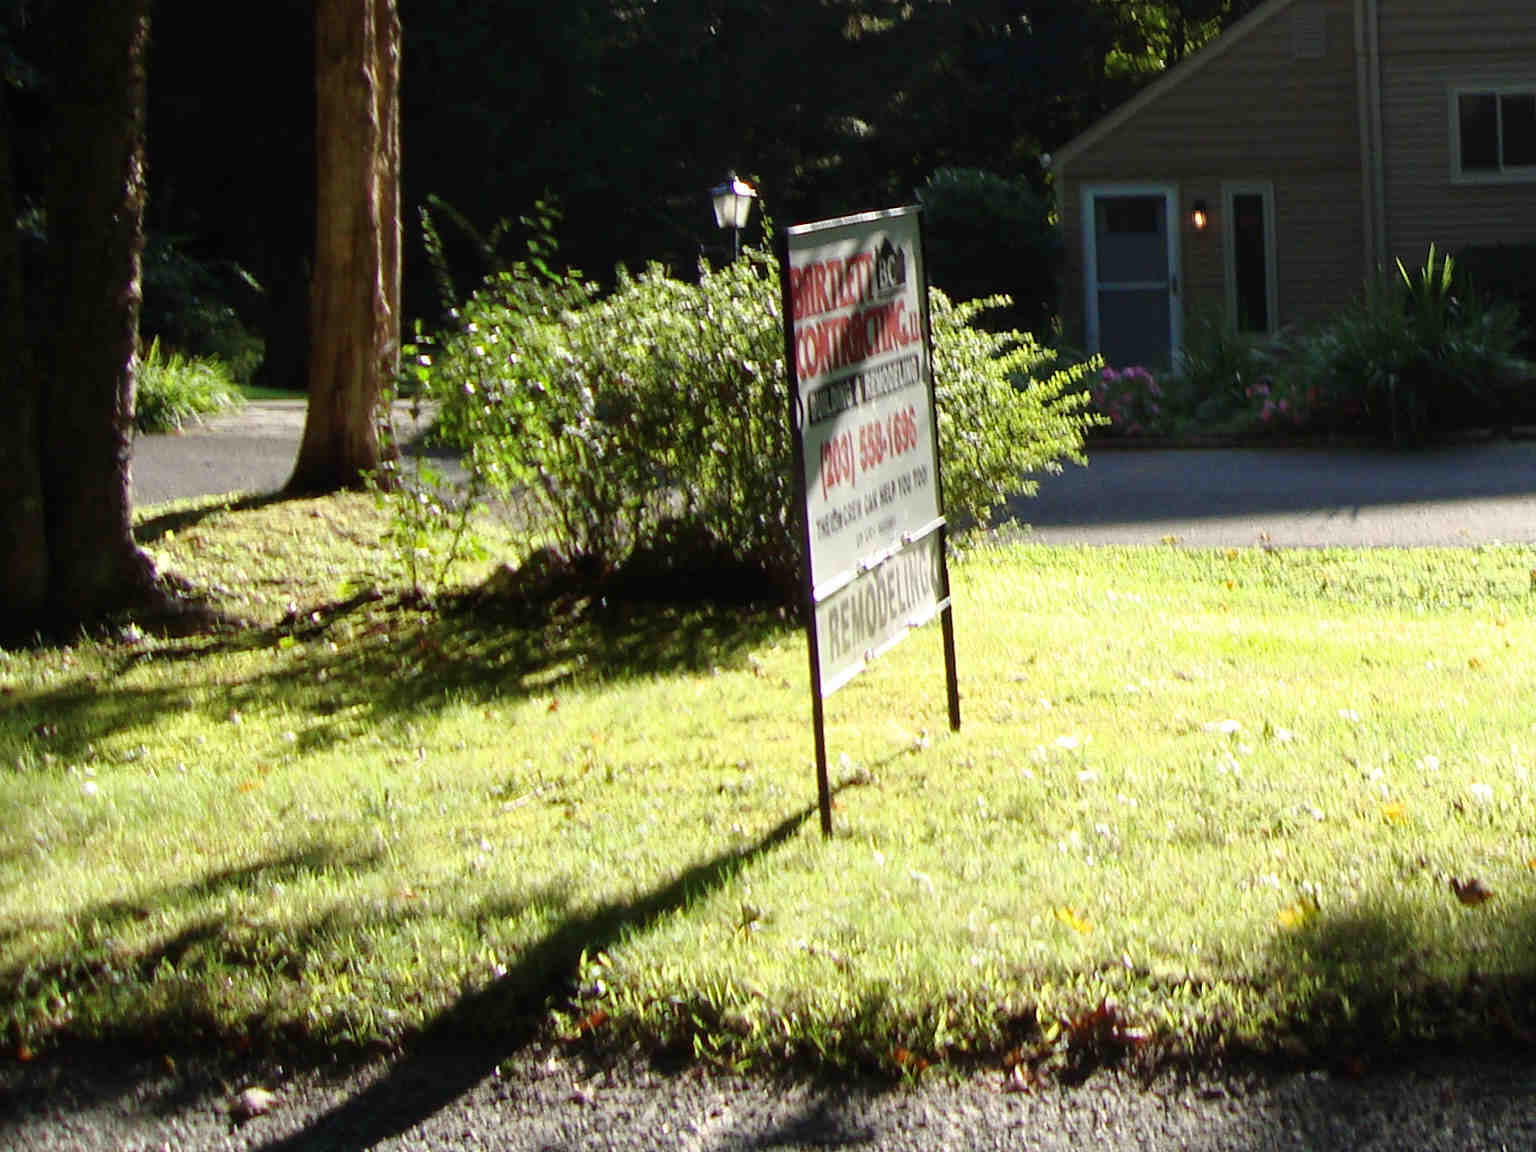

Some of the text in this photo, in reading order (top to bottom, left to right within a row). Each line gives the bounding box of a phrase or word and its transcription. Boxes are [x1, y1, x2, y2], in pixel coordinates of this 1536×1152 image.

[789, 251, 873, 320] BARTLETT
[820, 430, 856, 502] (203)
[897, 472, 912, 500] YOU
[828, 547, 929, 664] REMODELING
